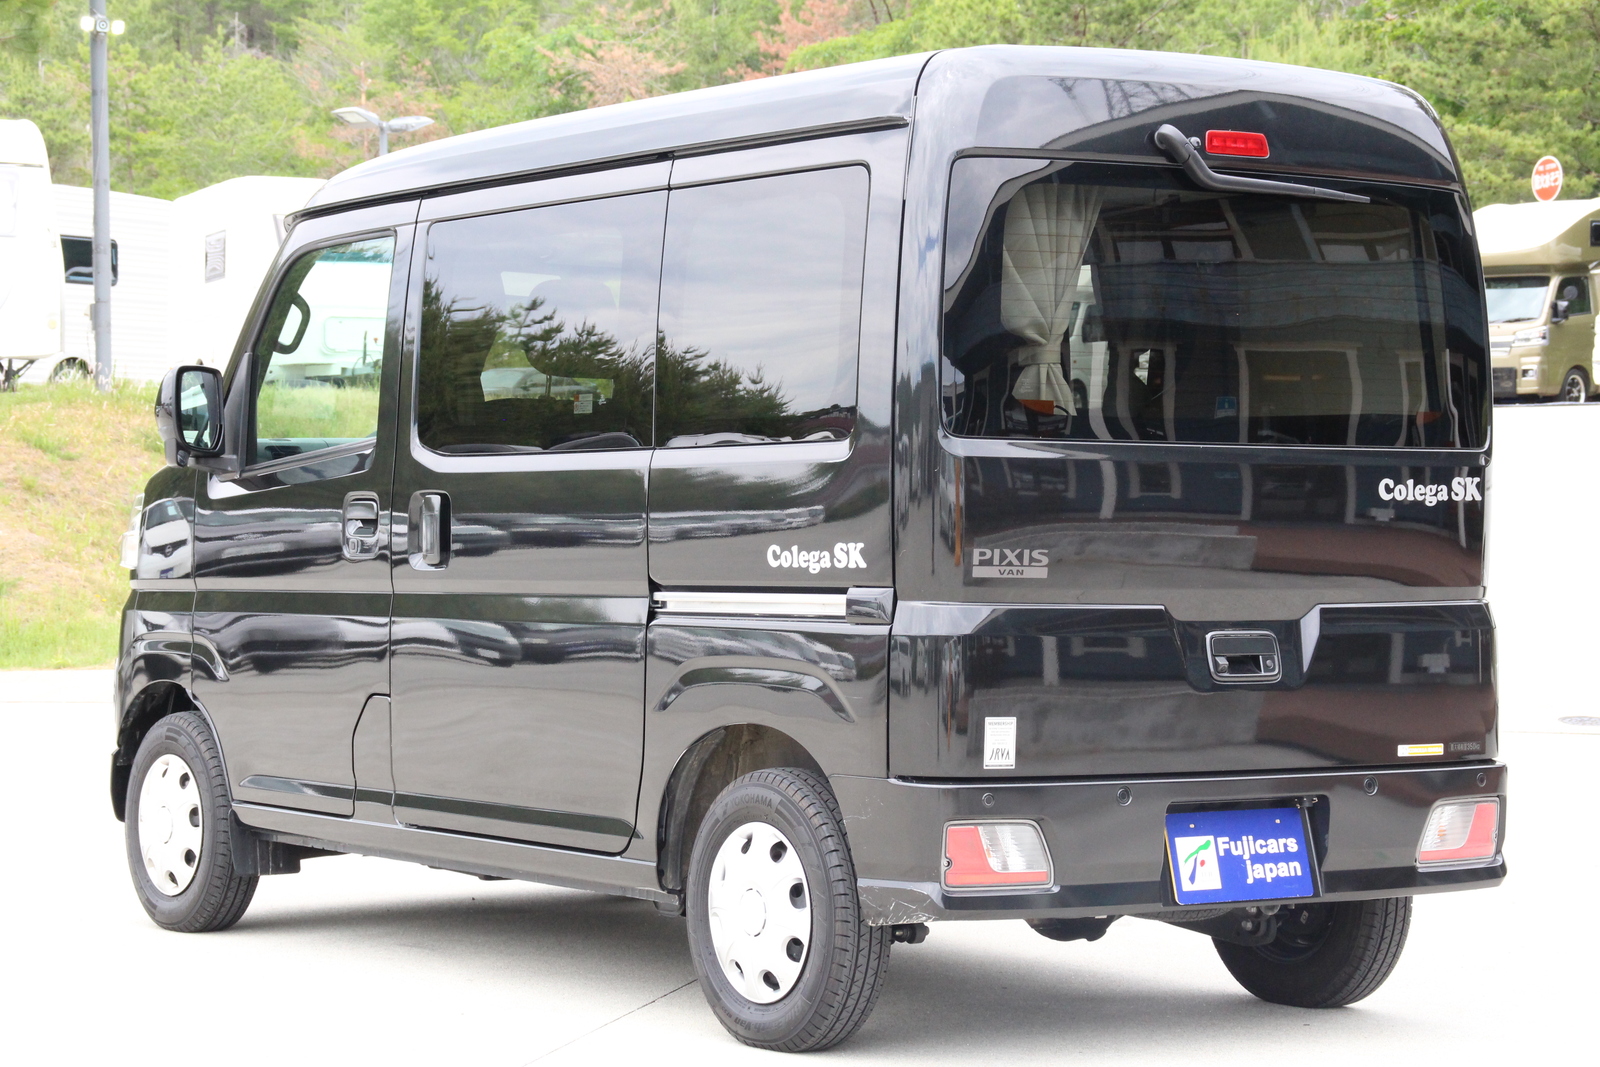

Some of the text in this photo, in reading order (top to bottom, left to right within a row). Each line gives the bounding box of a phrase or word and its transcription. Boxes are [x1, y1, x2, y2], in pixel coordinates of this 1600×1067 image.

[1378, 477, 1482, 507] Colega SK
[766, 542, 867, 574] Colega SK
[972, 548, 1049, 566] PIXIS
[998, 568, 1025, 576] VAN
[730, 793, 773, 809] YOKOHAMA
[1216, 835, 1299, 860] Fujicars
[1246, 860, 1302, 884] japan
